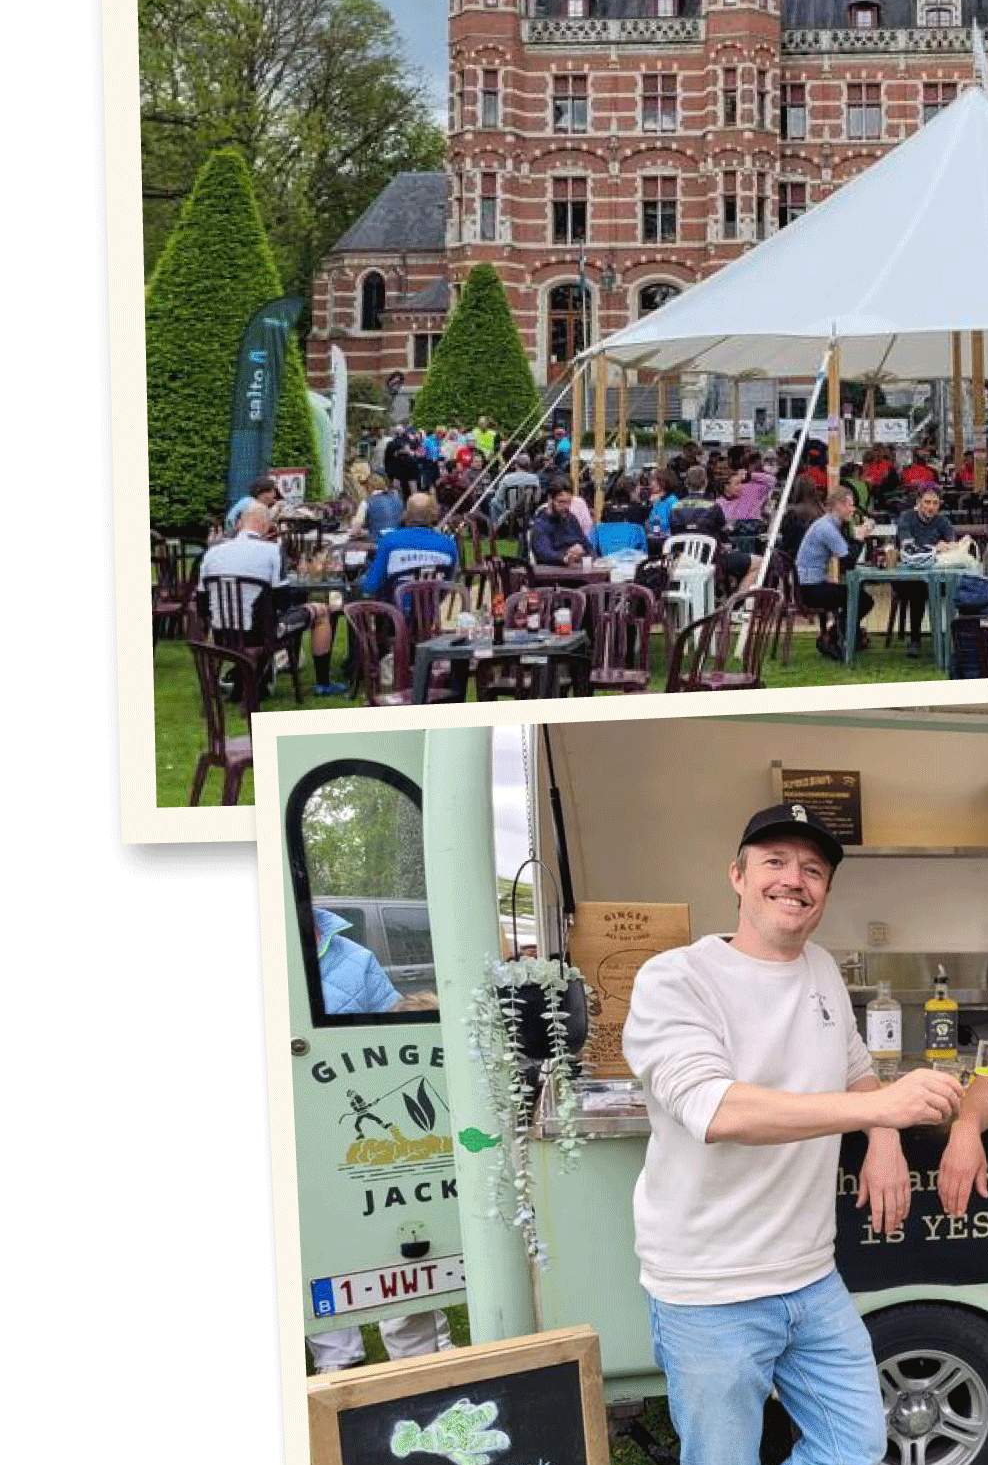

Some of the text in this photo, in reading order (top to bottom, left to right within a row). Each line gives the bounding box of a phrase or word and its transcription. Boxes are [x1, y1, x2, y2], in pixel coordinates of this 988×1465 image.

[613, 922, 643, 933] JACK
[362, 1177, 459, 1217] JACK
[318, 1299, 332, 1314] B
